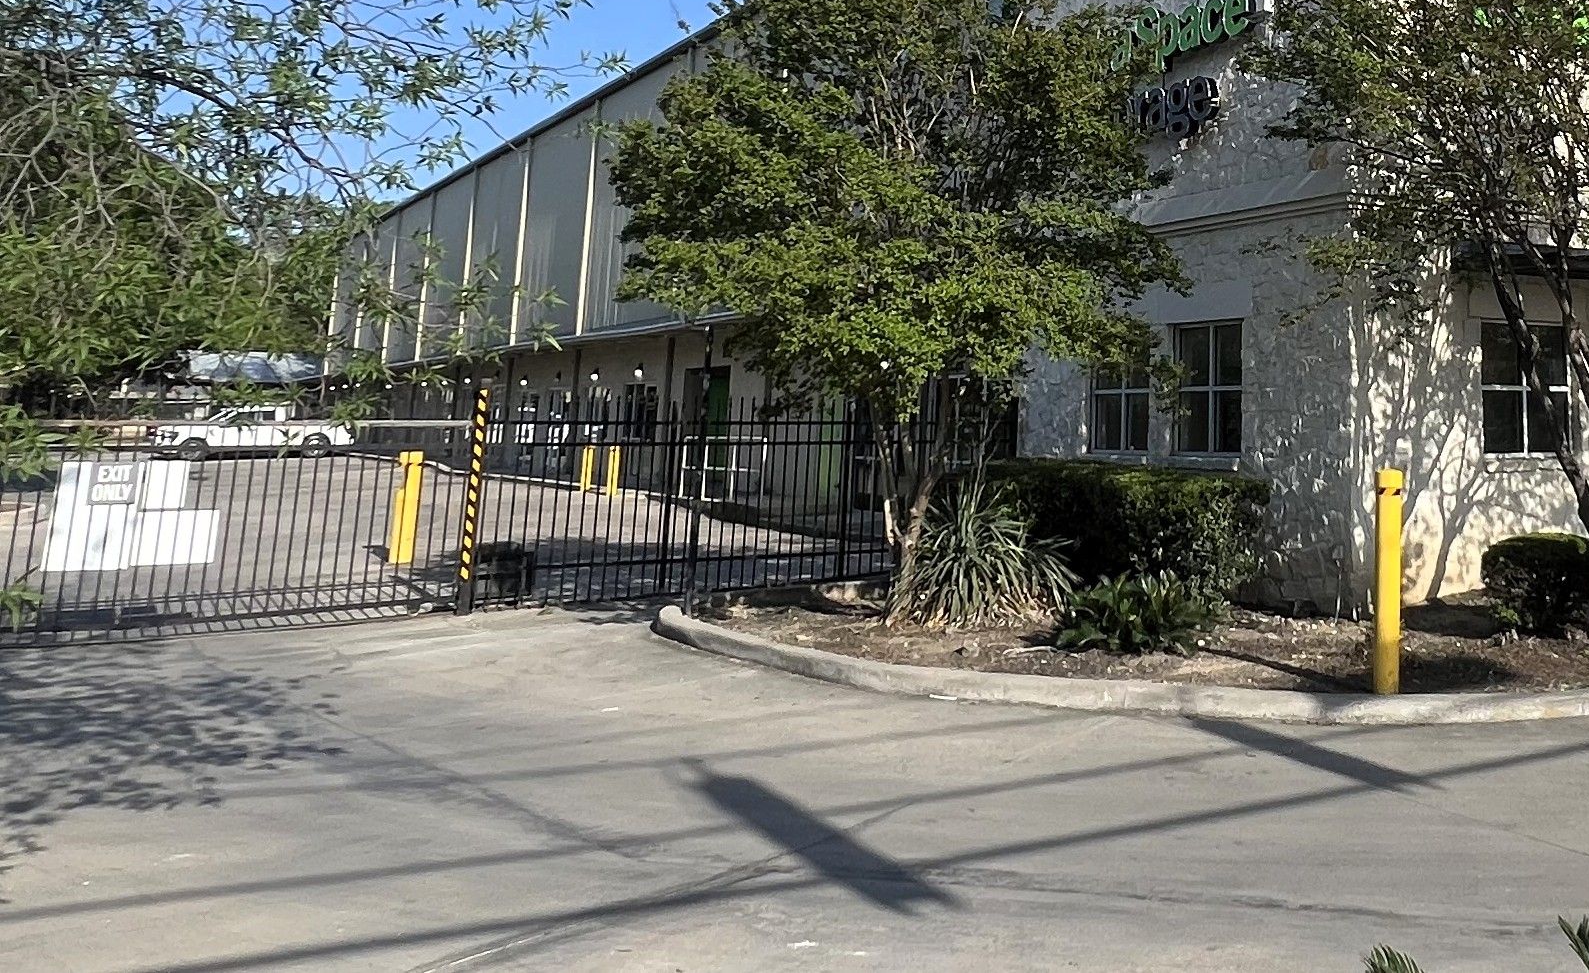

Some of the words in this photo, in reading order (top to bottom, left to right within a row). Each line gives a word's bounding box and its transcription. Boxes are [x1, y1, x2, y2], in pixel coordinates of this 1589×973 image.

[1131, 76, 1214, 139] rage
[97, 464, 134, 483] EXIT
[91, 483, 134, 502] ONLY
